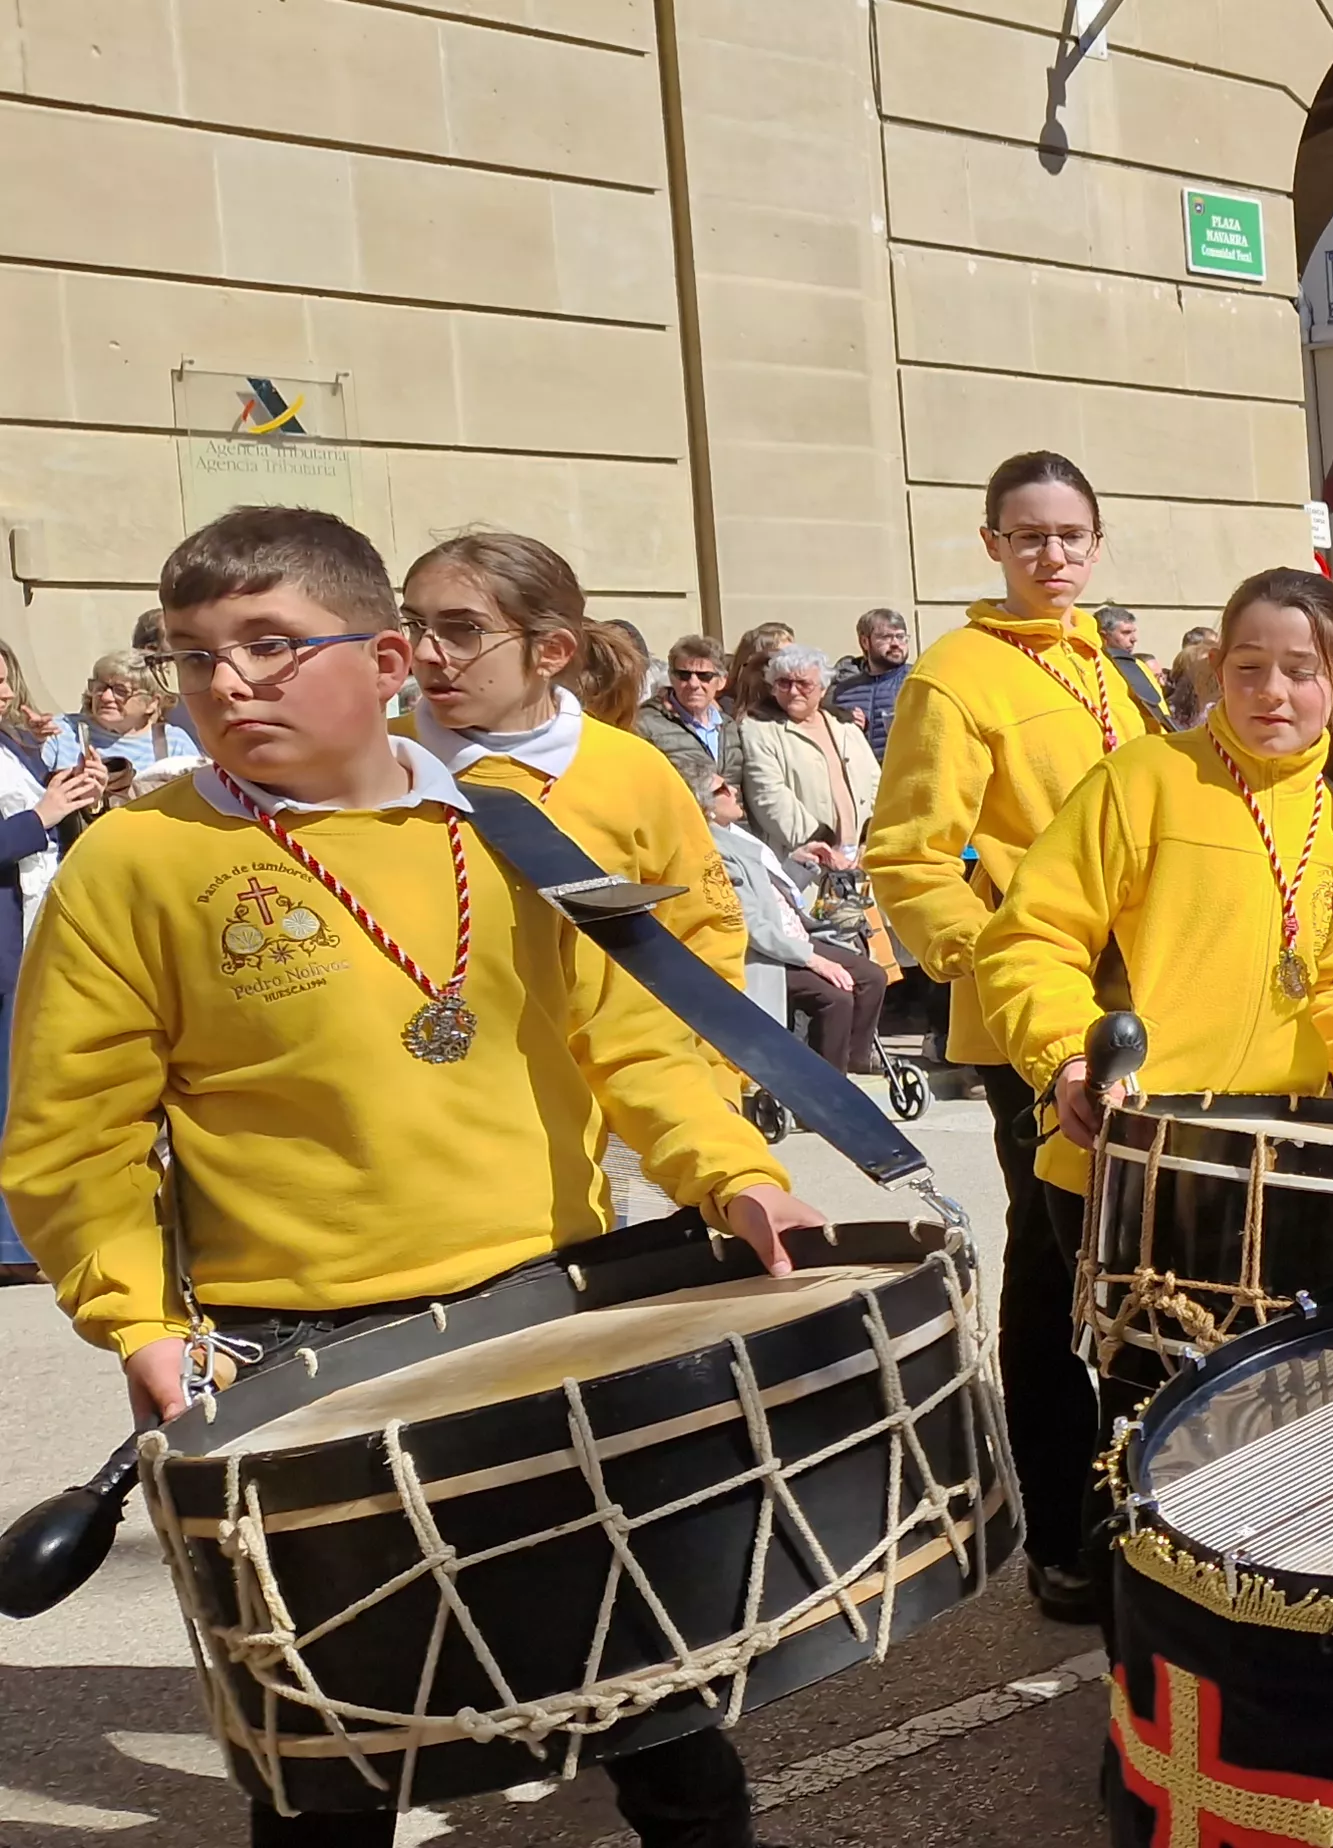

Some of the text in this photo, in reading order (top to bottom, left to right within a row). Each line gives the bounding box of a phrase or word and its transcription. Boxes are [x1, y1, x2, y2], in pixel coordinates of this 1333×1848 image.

[1211, 214, 1242, 231] PLAZA
[1205, 228, 1250, 247] NAVARRA
[206, 440, 347, 462] Agencia Tributaria
[196, 456, 337, 477] Agencia Tributaria
[197, 862, 315, 904] Banda de tambores
[231, 977, 282, 1001] Pedro
